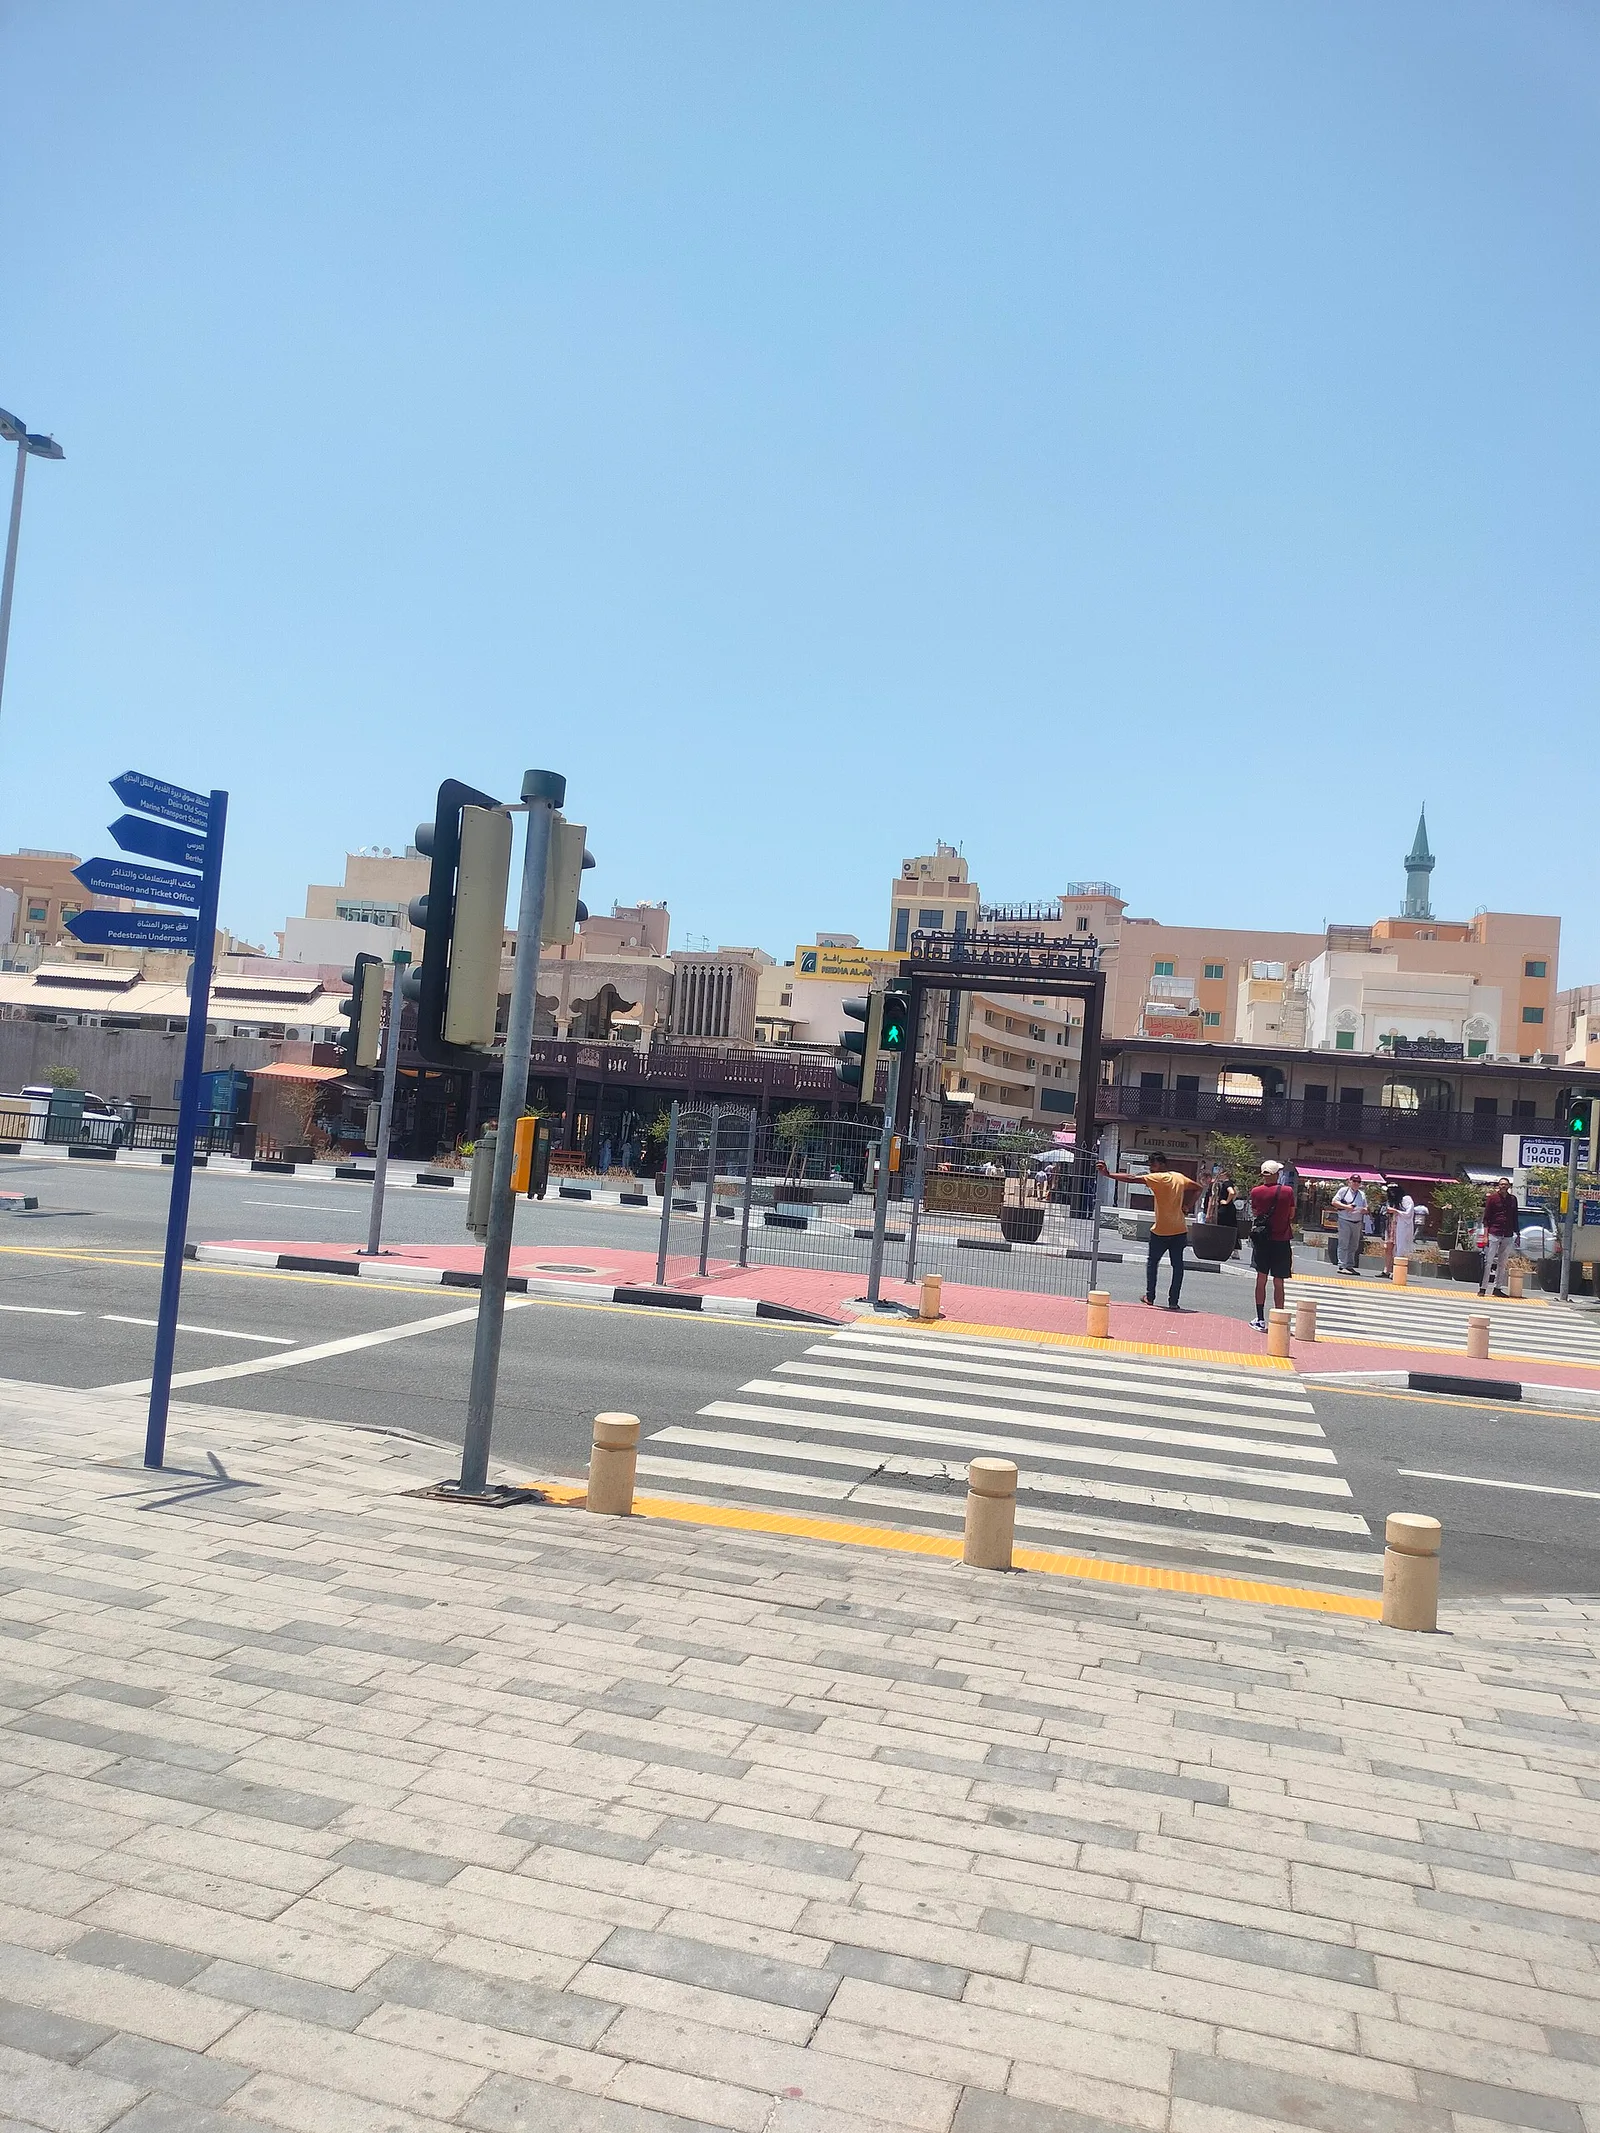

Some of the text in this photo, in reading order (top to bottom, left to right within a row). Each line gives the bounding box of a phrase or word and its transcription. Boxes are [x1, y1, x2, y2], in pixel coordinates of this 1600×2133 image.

[140, 800, 208, 828] Marine Transport Station
[168, 798, 208, 820] Deira Old Souq
[185, 852, 204, 864] Berths
[111, 868, 137, 880] والتذاكر
[90, 878, 195, 902] Information and Ticket Office
[178, 880, 196, 889] مكتب
[136, 920, 189, 931] نفق عبور المشاة
[148, 934, 188, 944] Underpass
[911, 946, 1099, 970] OLD BALADIYA STREET
[1166, 1140, 1190, 1149] STORE
[1526, 1146, 1562, 1156] 10 AED
[1532, 1155, 1560, 1164] HOUR
